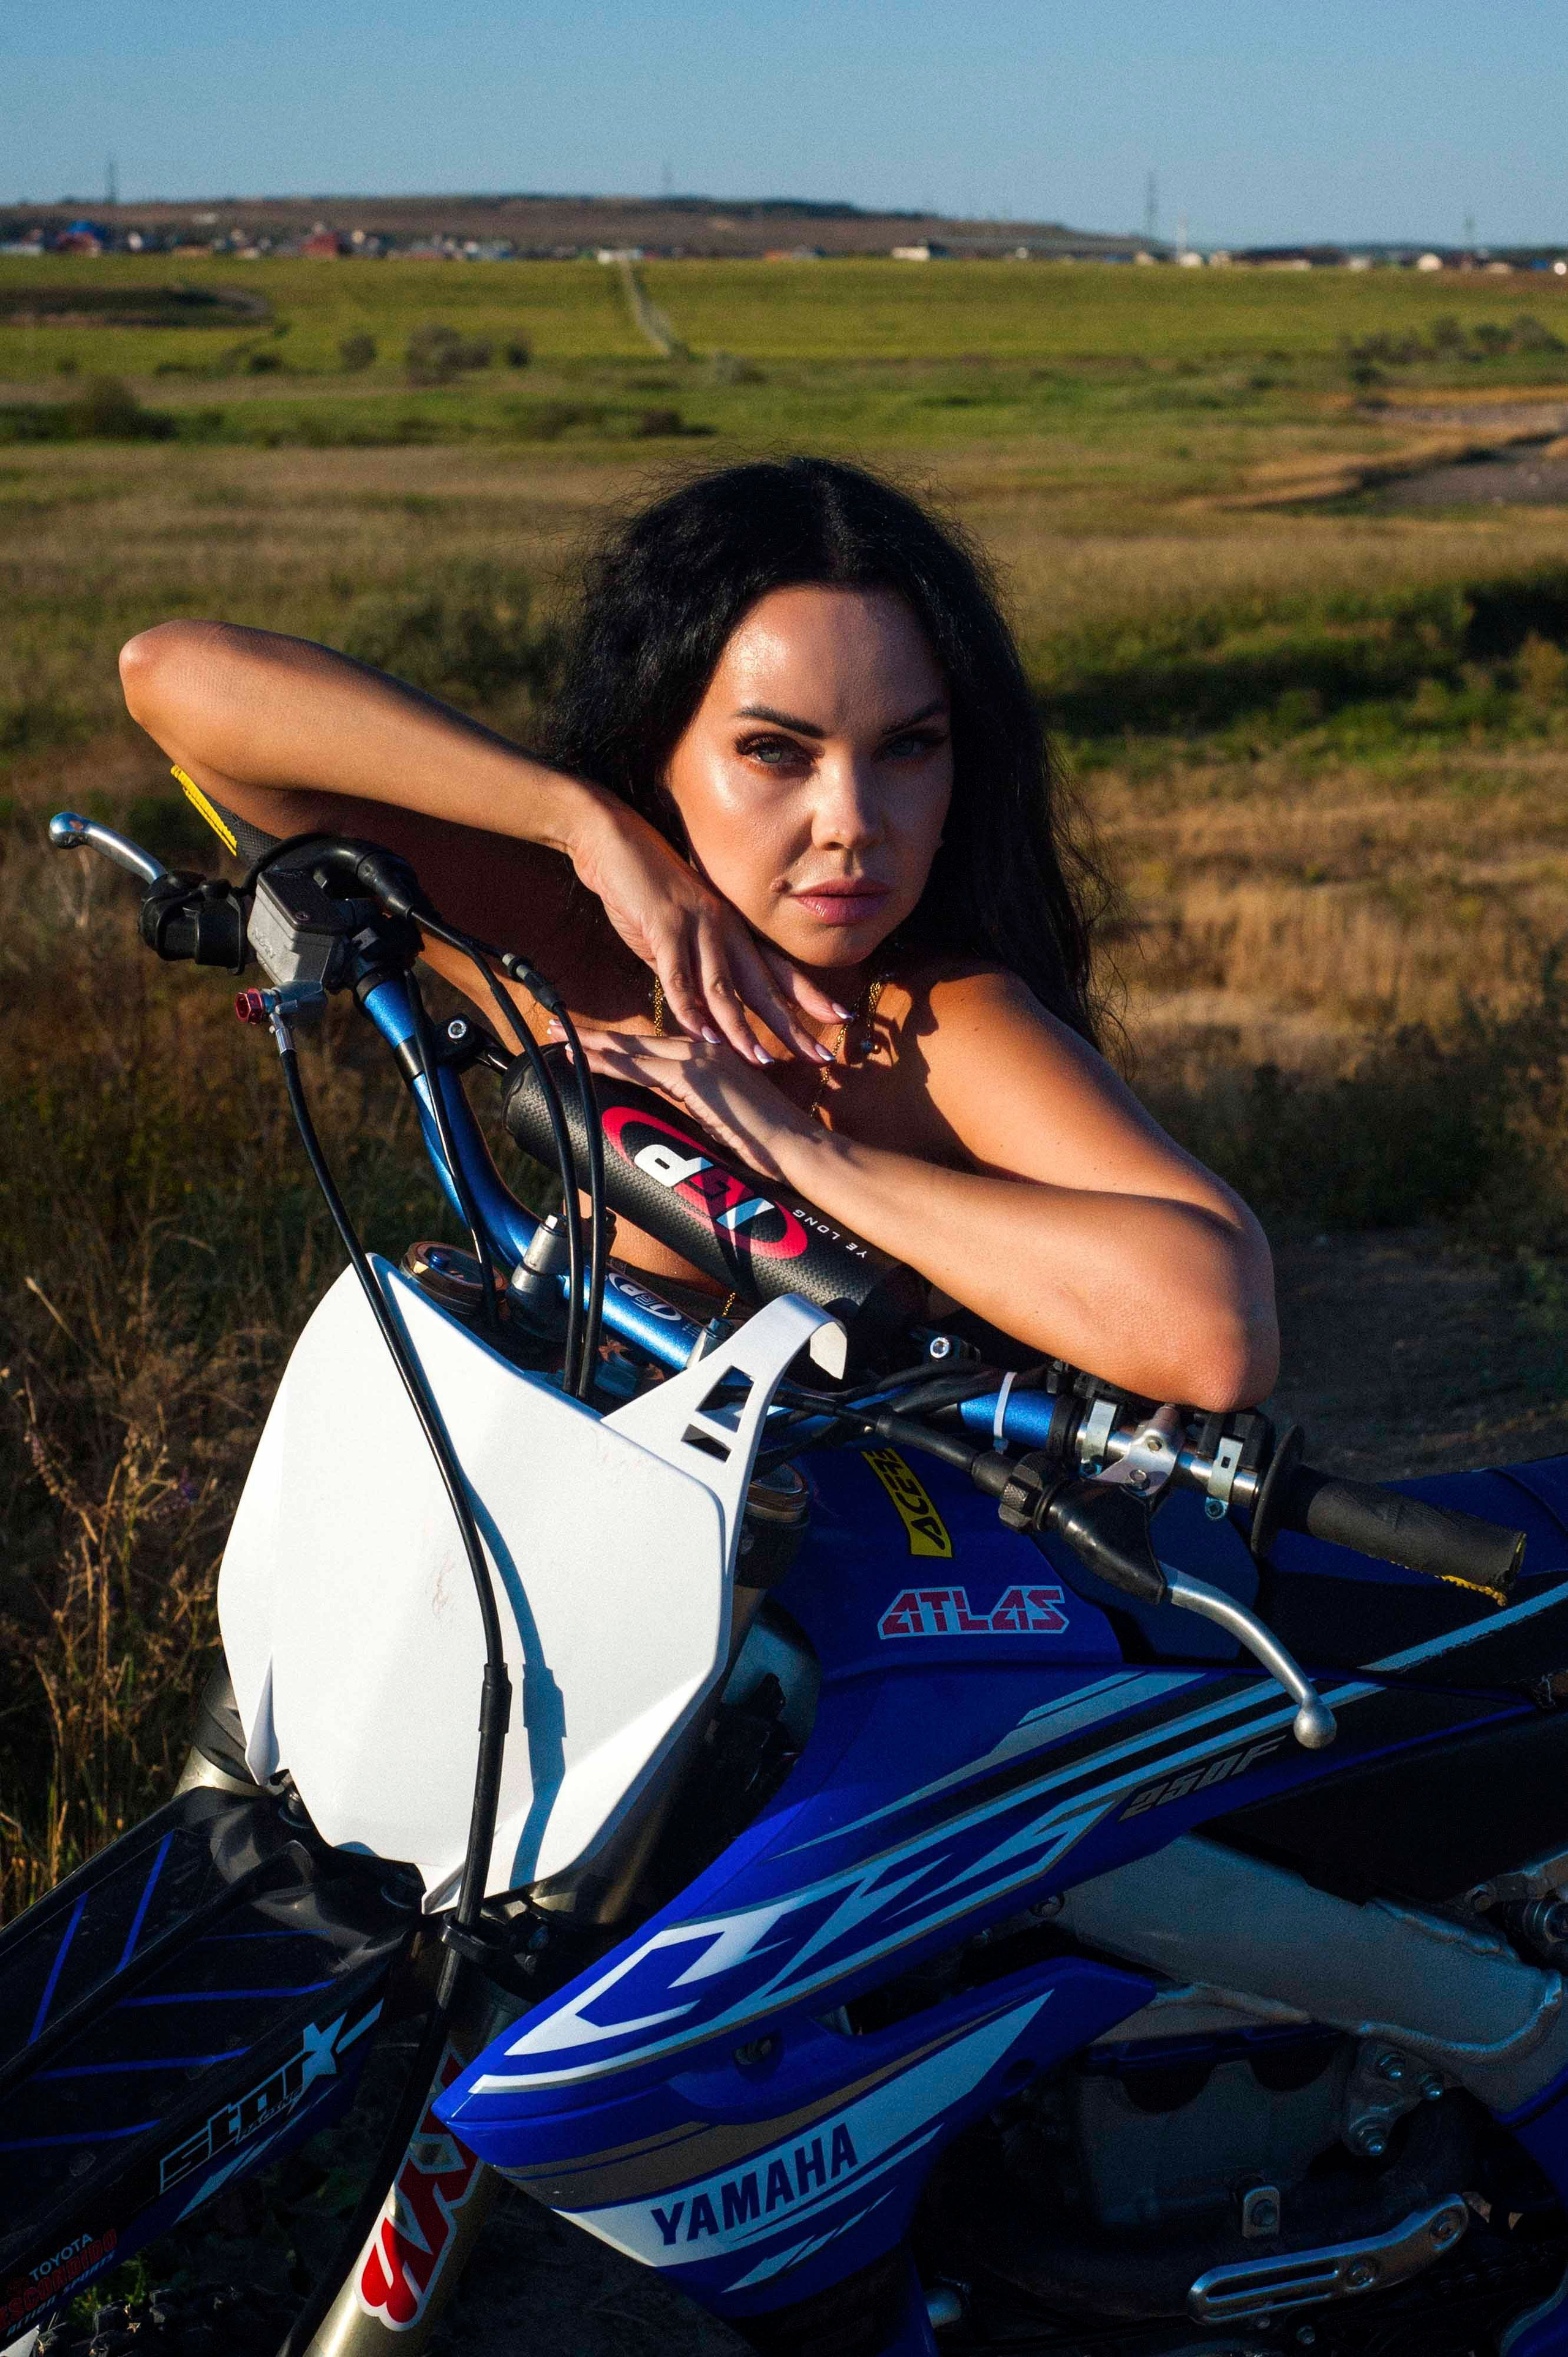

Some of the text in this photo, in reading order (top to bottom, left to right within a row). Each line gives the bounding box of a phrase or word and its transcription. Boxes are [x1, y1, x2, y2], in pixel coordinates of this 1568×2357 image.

[793, 1209, 867, 1258] YE LONG
[877, 1586, 1069, 1640] ATLAS
[1118, 1735, 1288, 1822] 250F
[650, 2122, 858, 2245] YAMAHA
[29, 2234, 92, 2281] TOYOTA
